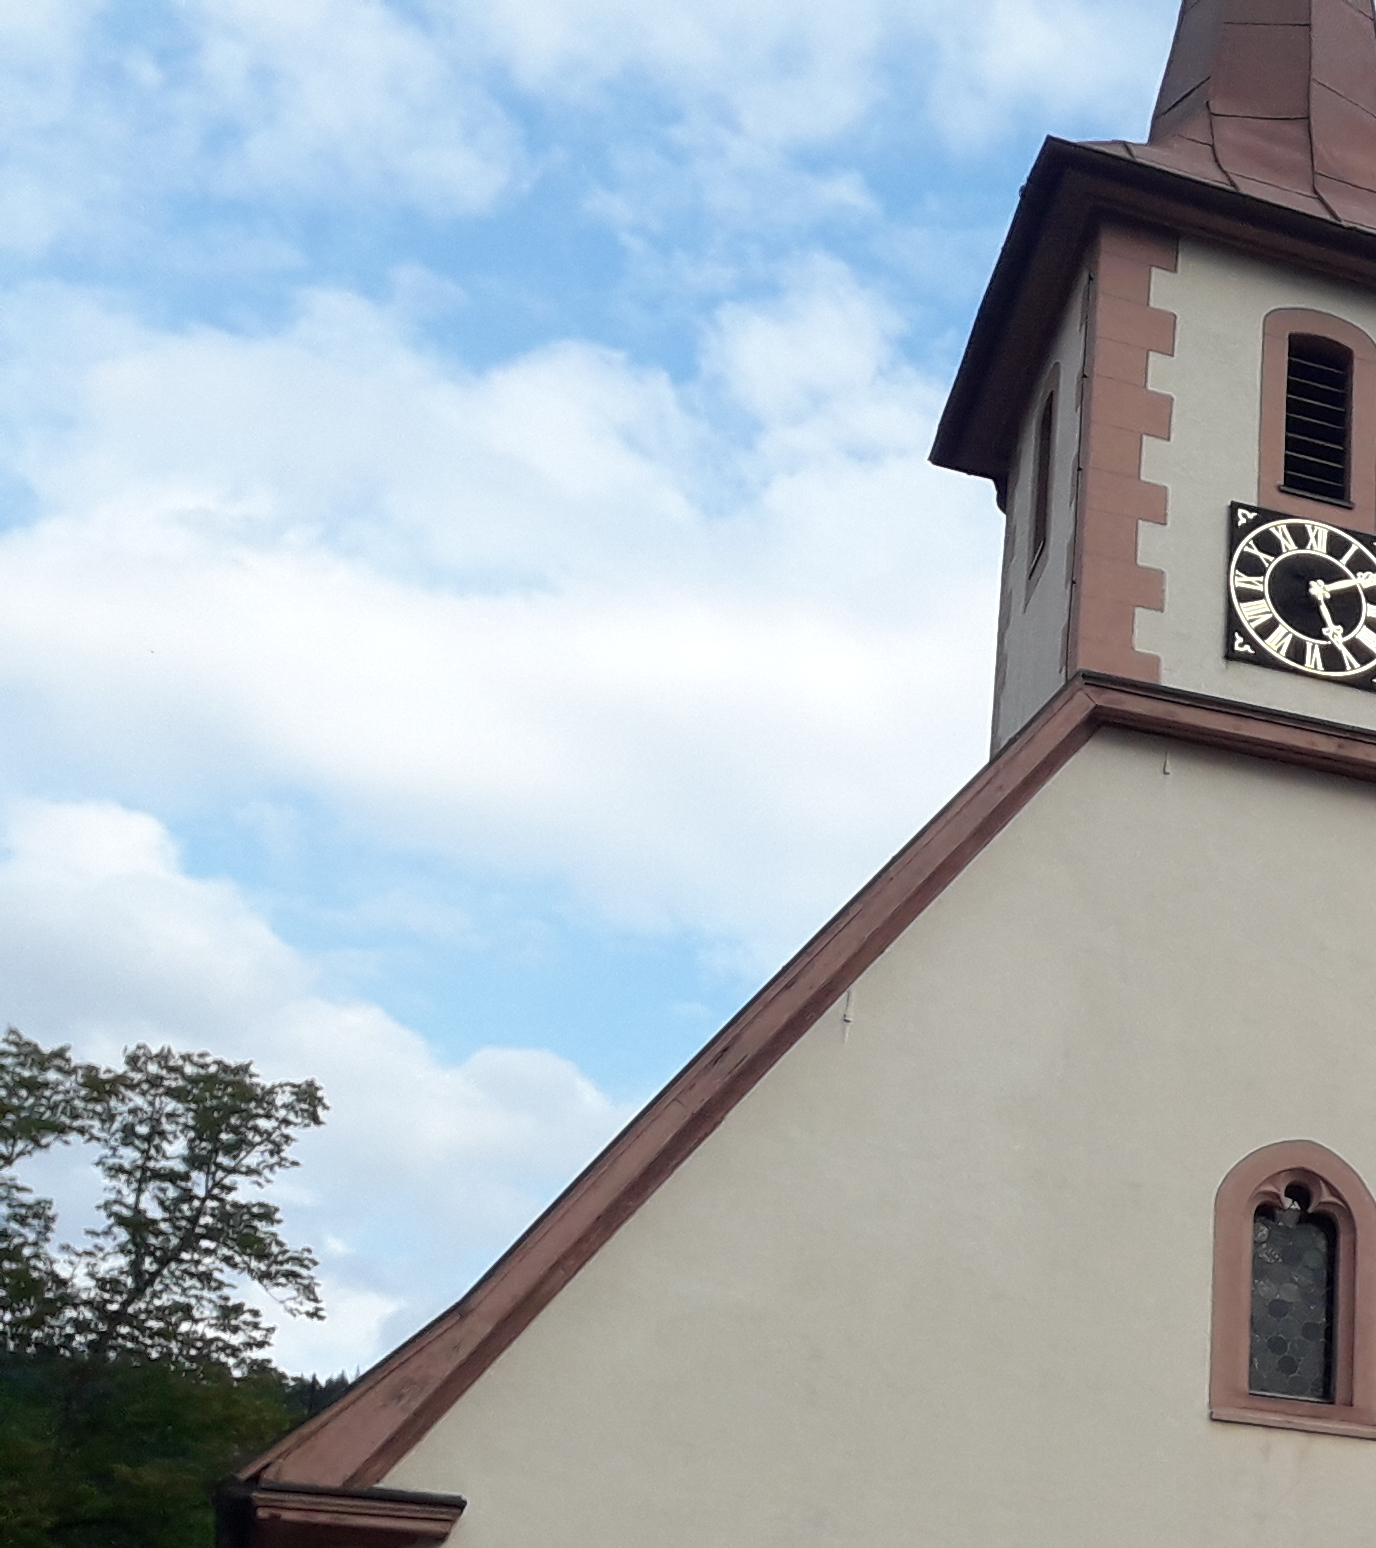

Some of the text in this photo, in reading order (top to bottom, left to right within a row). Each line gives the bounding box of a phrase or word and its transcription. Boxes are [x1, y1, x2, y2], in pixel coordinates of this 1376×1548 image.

[1269, 523, 1298, 553] XI
[1305, 523, 1329, 554] XII
[1243, 540, 1275, 567] X
[1235, 569, 1264, 592] IX
[1305, 641, 1324, 671] VI
